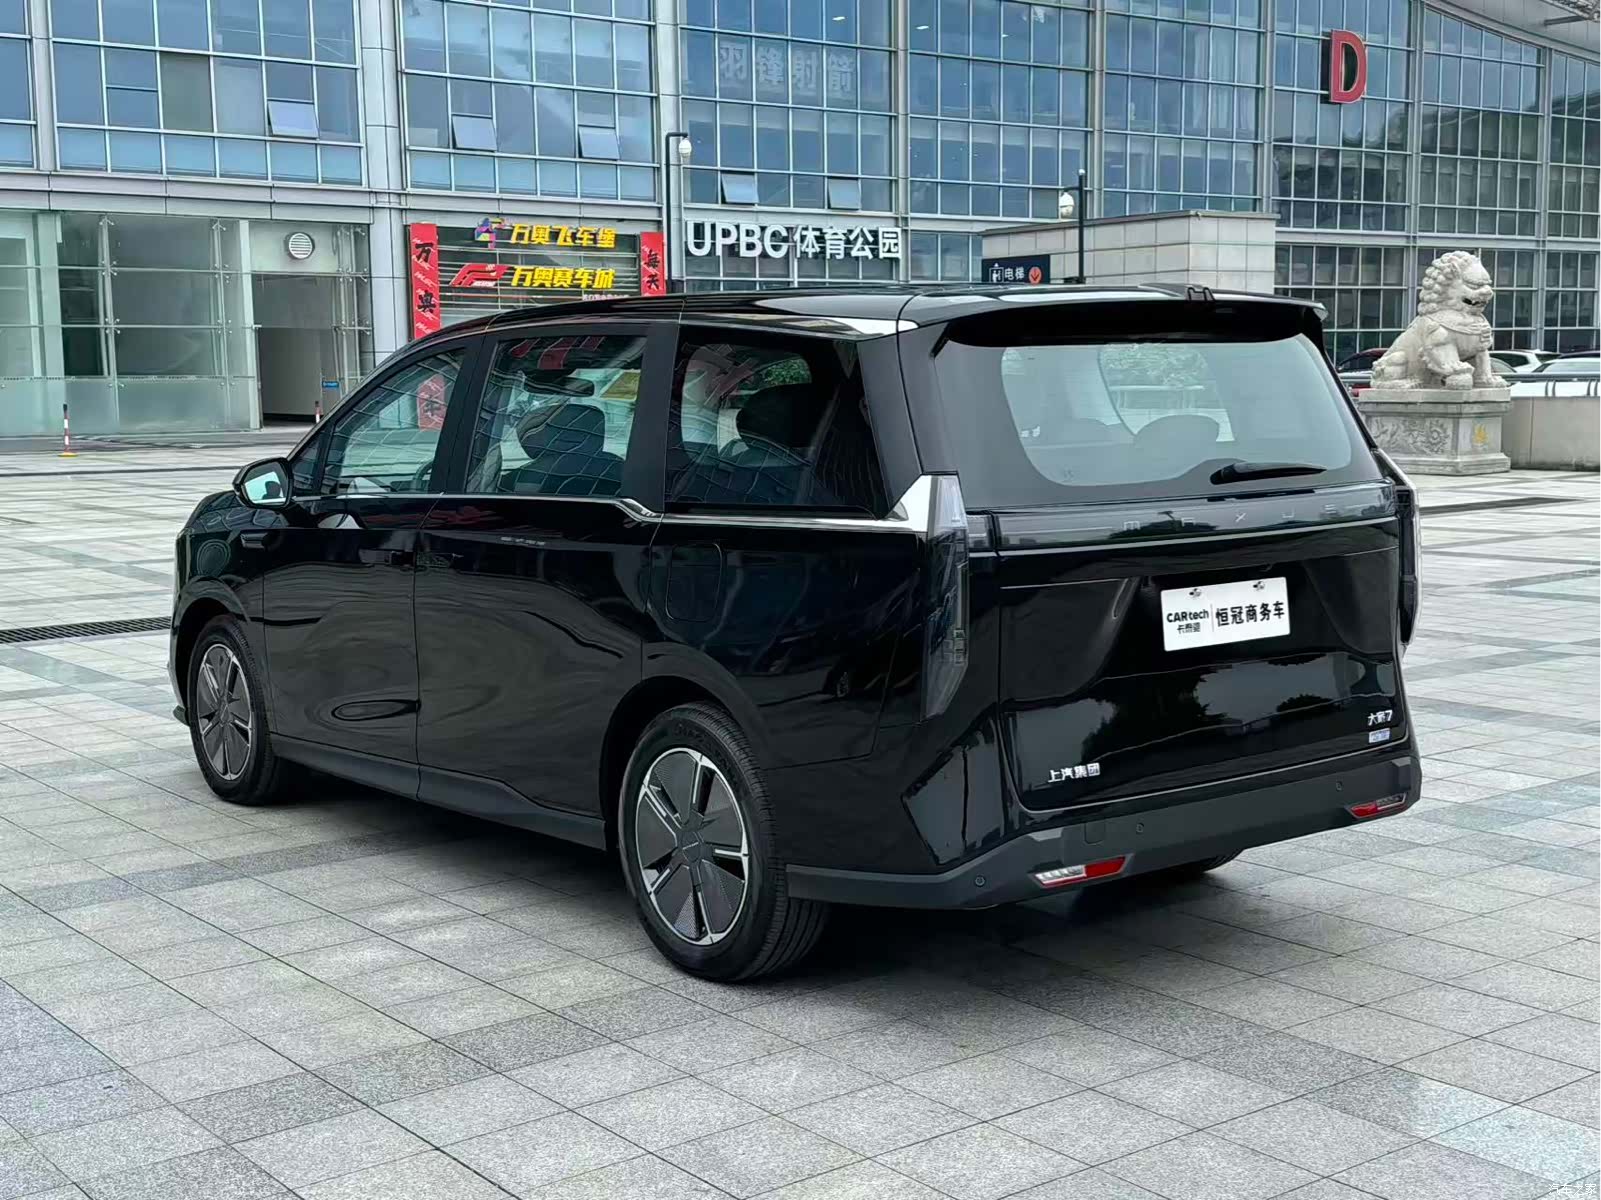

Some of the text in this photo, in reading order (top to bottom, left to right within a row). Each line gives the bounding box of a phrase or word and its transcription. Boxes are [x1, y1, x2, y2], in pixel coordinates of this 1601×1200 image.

[1331, 29, 1367, 103] D
[510, 223, 617, 249] 万奥飞车堡
[687, 220, 902, 260] UPBC 体育公园
[510, 265, 616, 289] 万奥赛车城
[1004, 266, 1025, 280] 电梯
[1215, 601, 1285, 627] 恒冠商务车
[1047, 762, 1101, 783] 上汽集团
